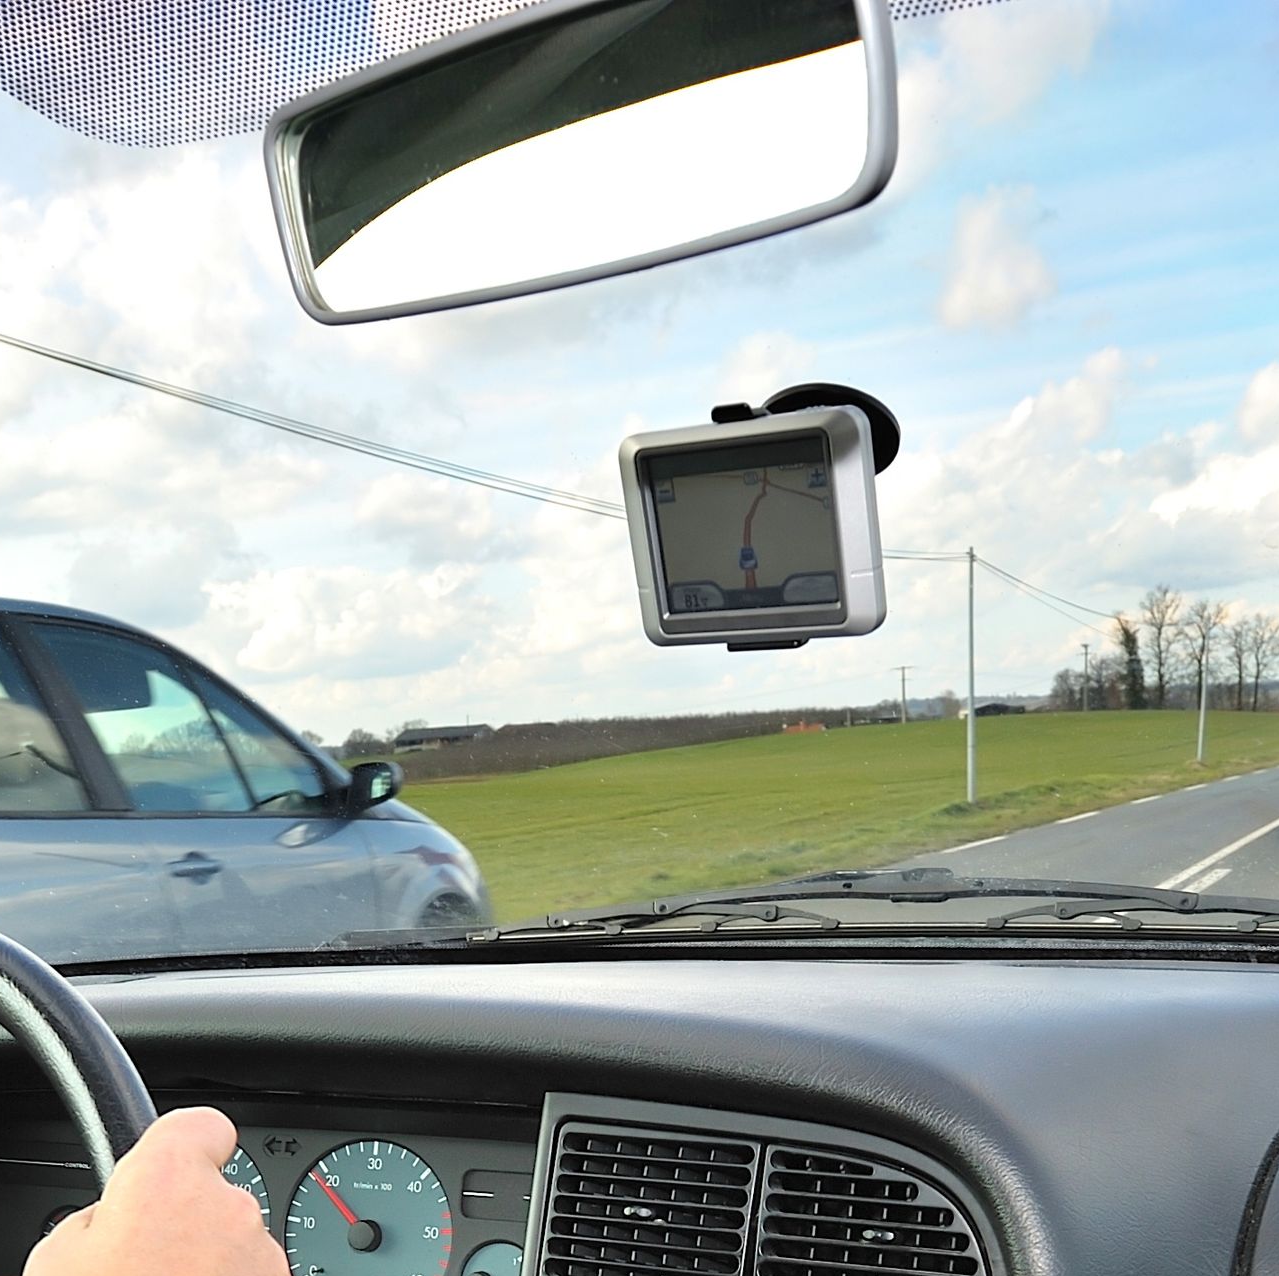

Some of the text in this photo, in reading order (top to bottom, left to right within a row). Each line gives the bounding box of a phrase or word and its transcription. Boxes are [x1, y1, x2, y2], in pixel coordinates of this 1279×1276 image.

[367, 1157, 383, 1170] 30
[325, 1174, 340, 1187] 20
[406, 1180, 422, 1193] 40
[303, 1216, 315, 1229] 10
[423, 1226, 439, 1239] 50
